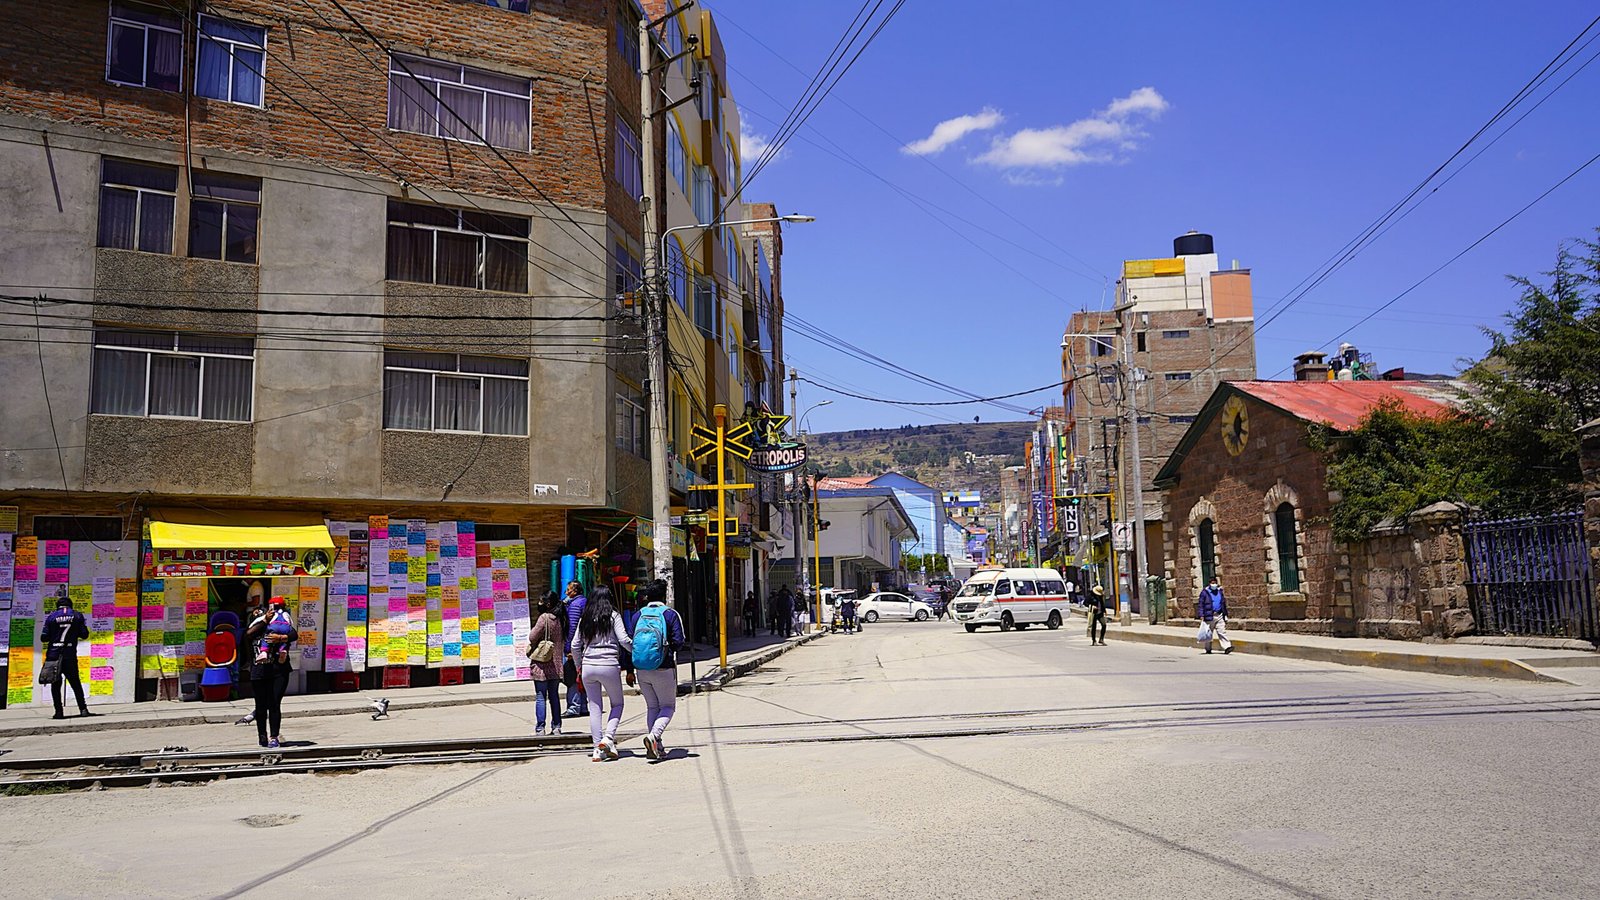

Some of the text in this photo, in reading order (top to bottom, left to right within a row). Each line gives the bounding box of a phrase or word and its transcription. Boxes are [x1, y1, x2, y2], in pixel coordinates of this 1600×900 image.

[751, 449, 805, 466] ETROPOLIS
[158, 549, 298, 562] PLASTICENTRO
[60, 623, 71, 642] 7
